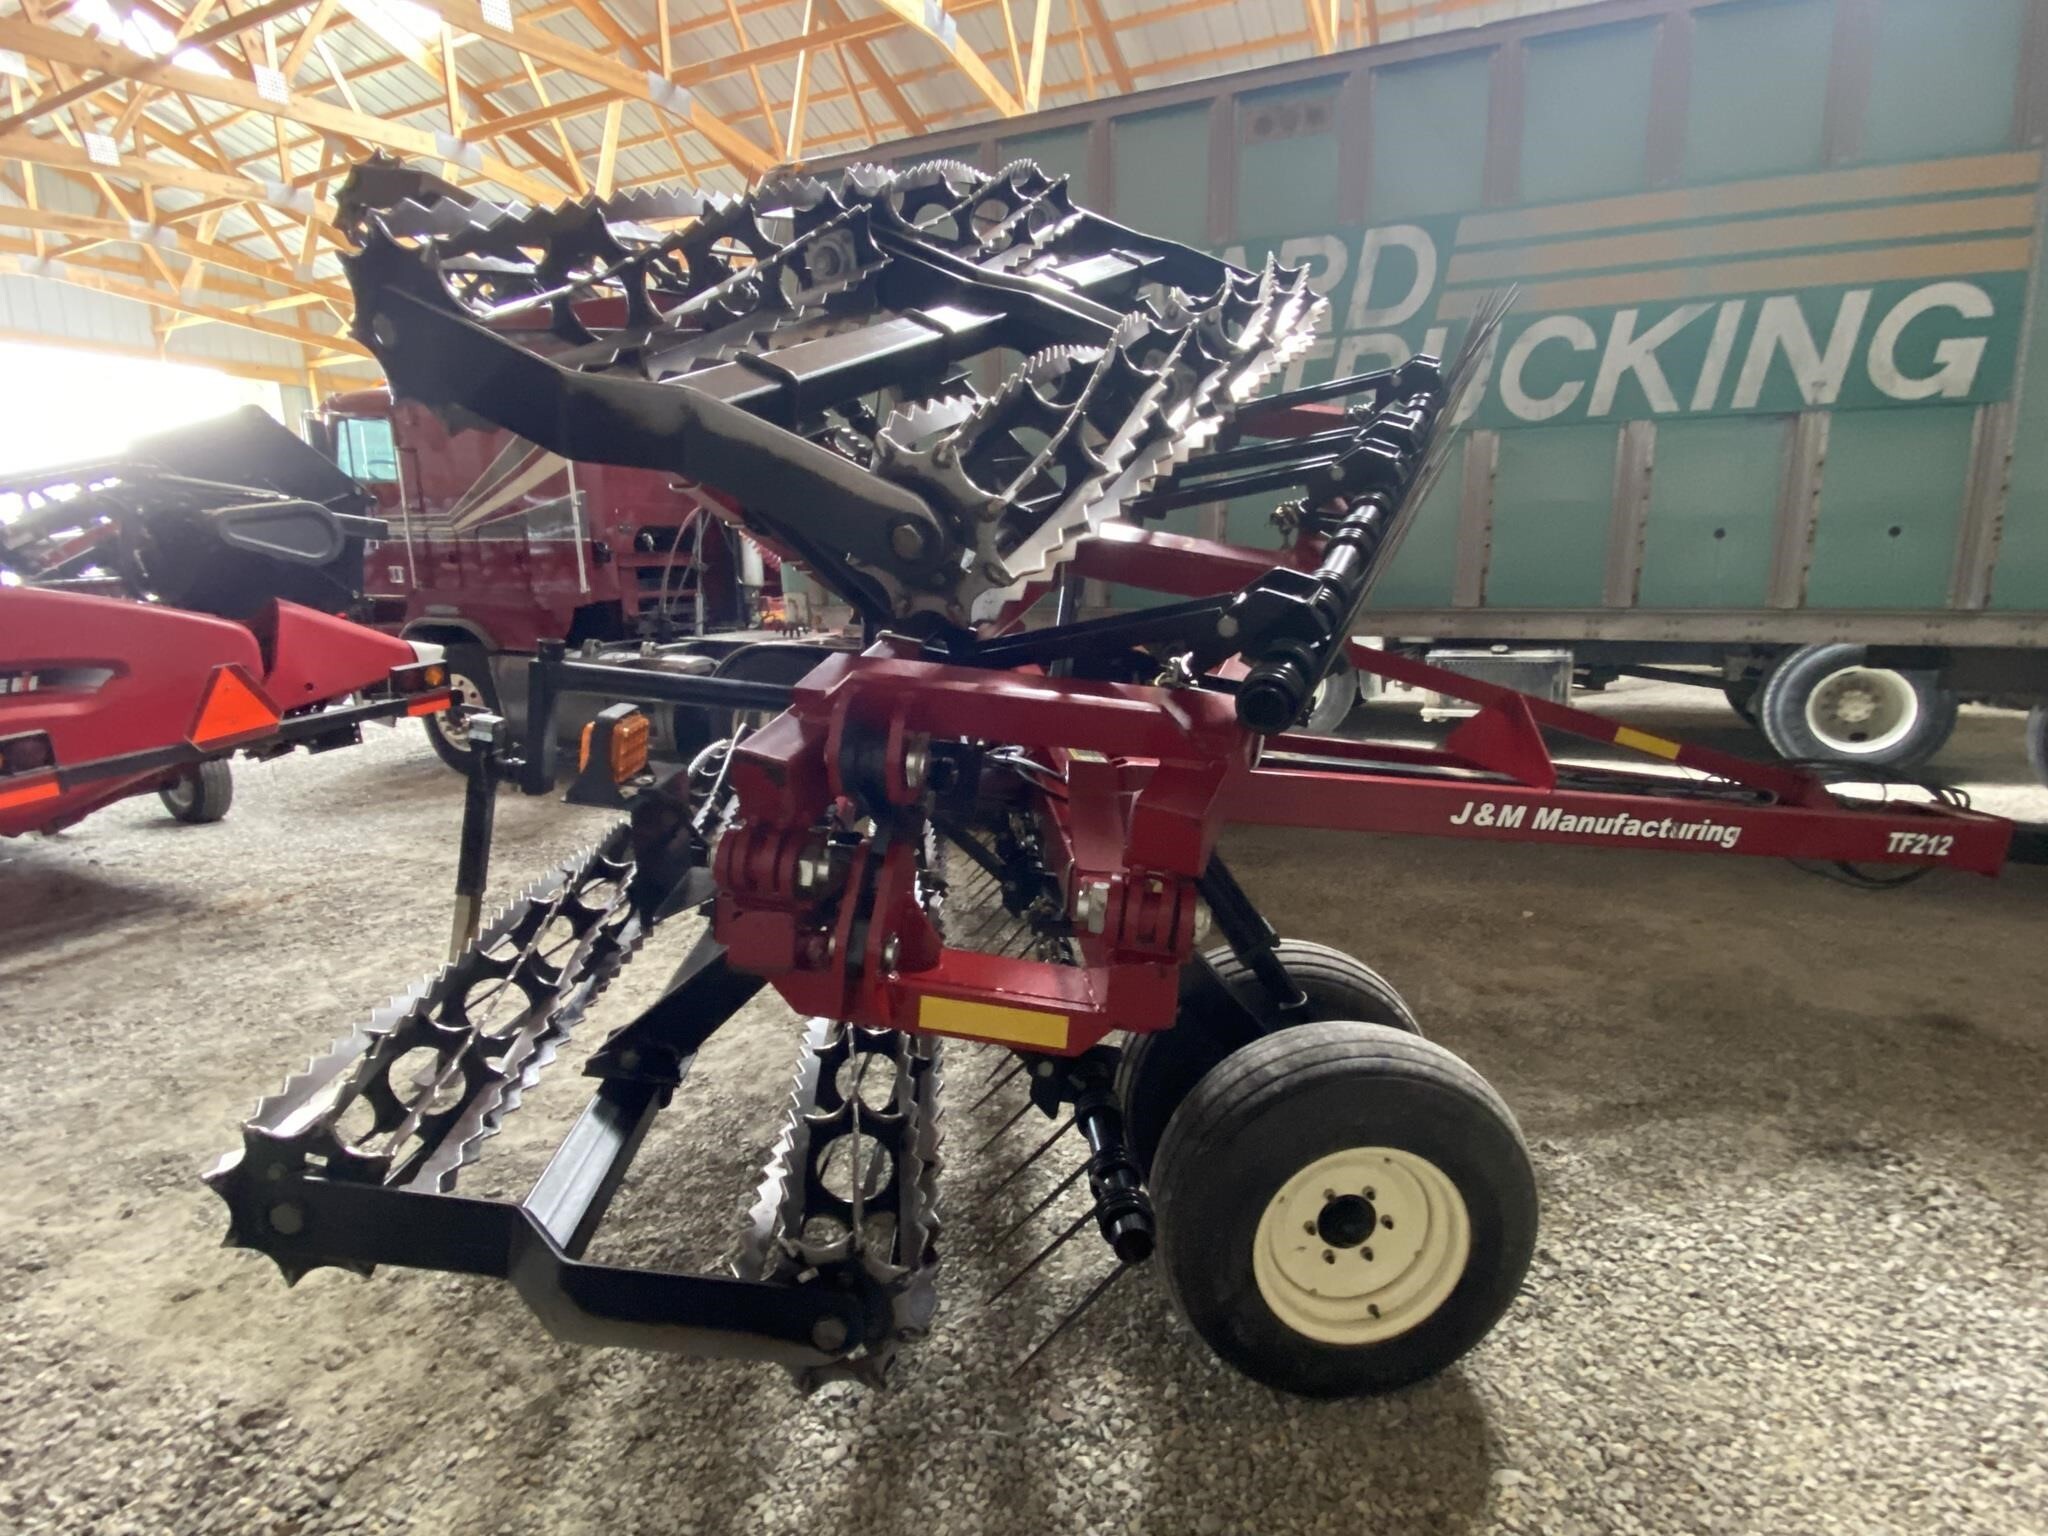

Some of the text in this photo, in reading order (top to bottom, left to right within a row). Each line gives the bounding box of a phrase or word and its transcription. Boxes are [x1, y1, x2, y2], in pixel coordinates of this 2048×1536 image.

[1450, 801, 1743, 849] J&M Manufacturing
[1887, 831, 1954, 856] TF212
